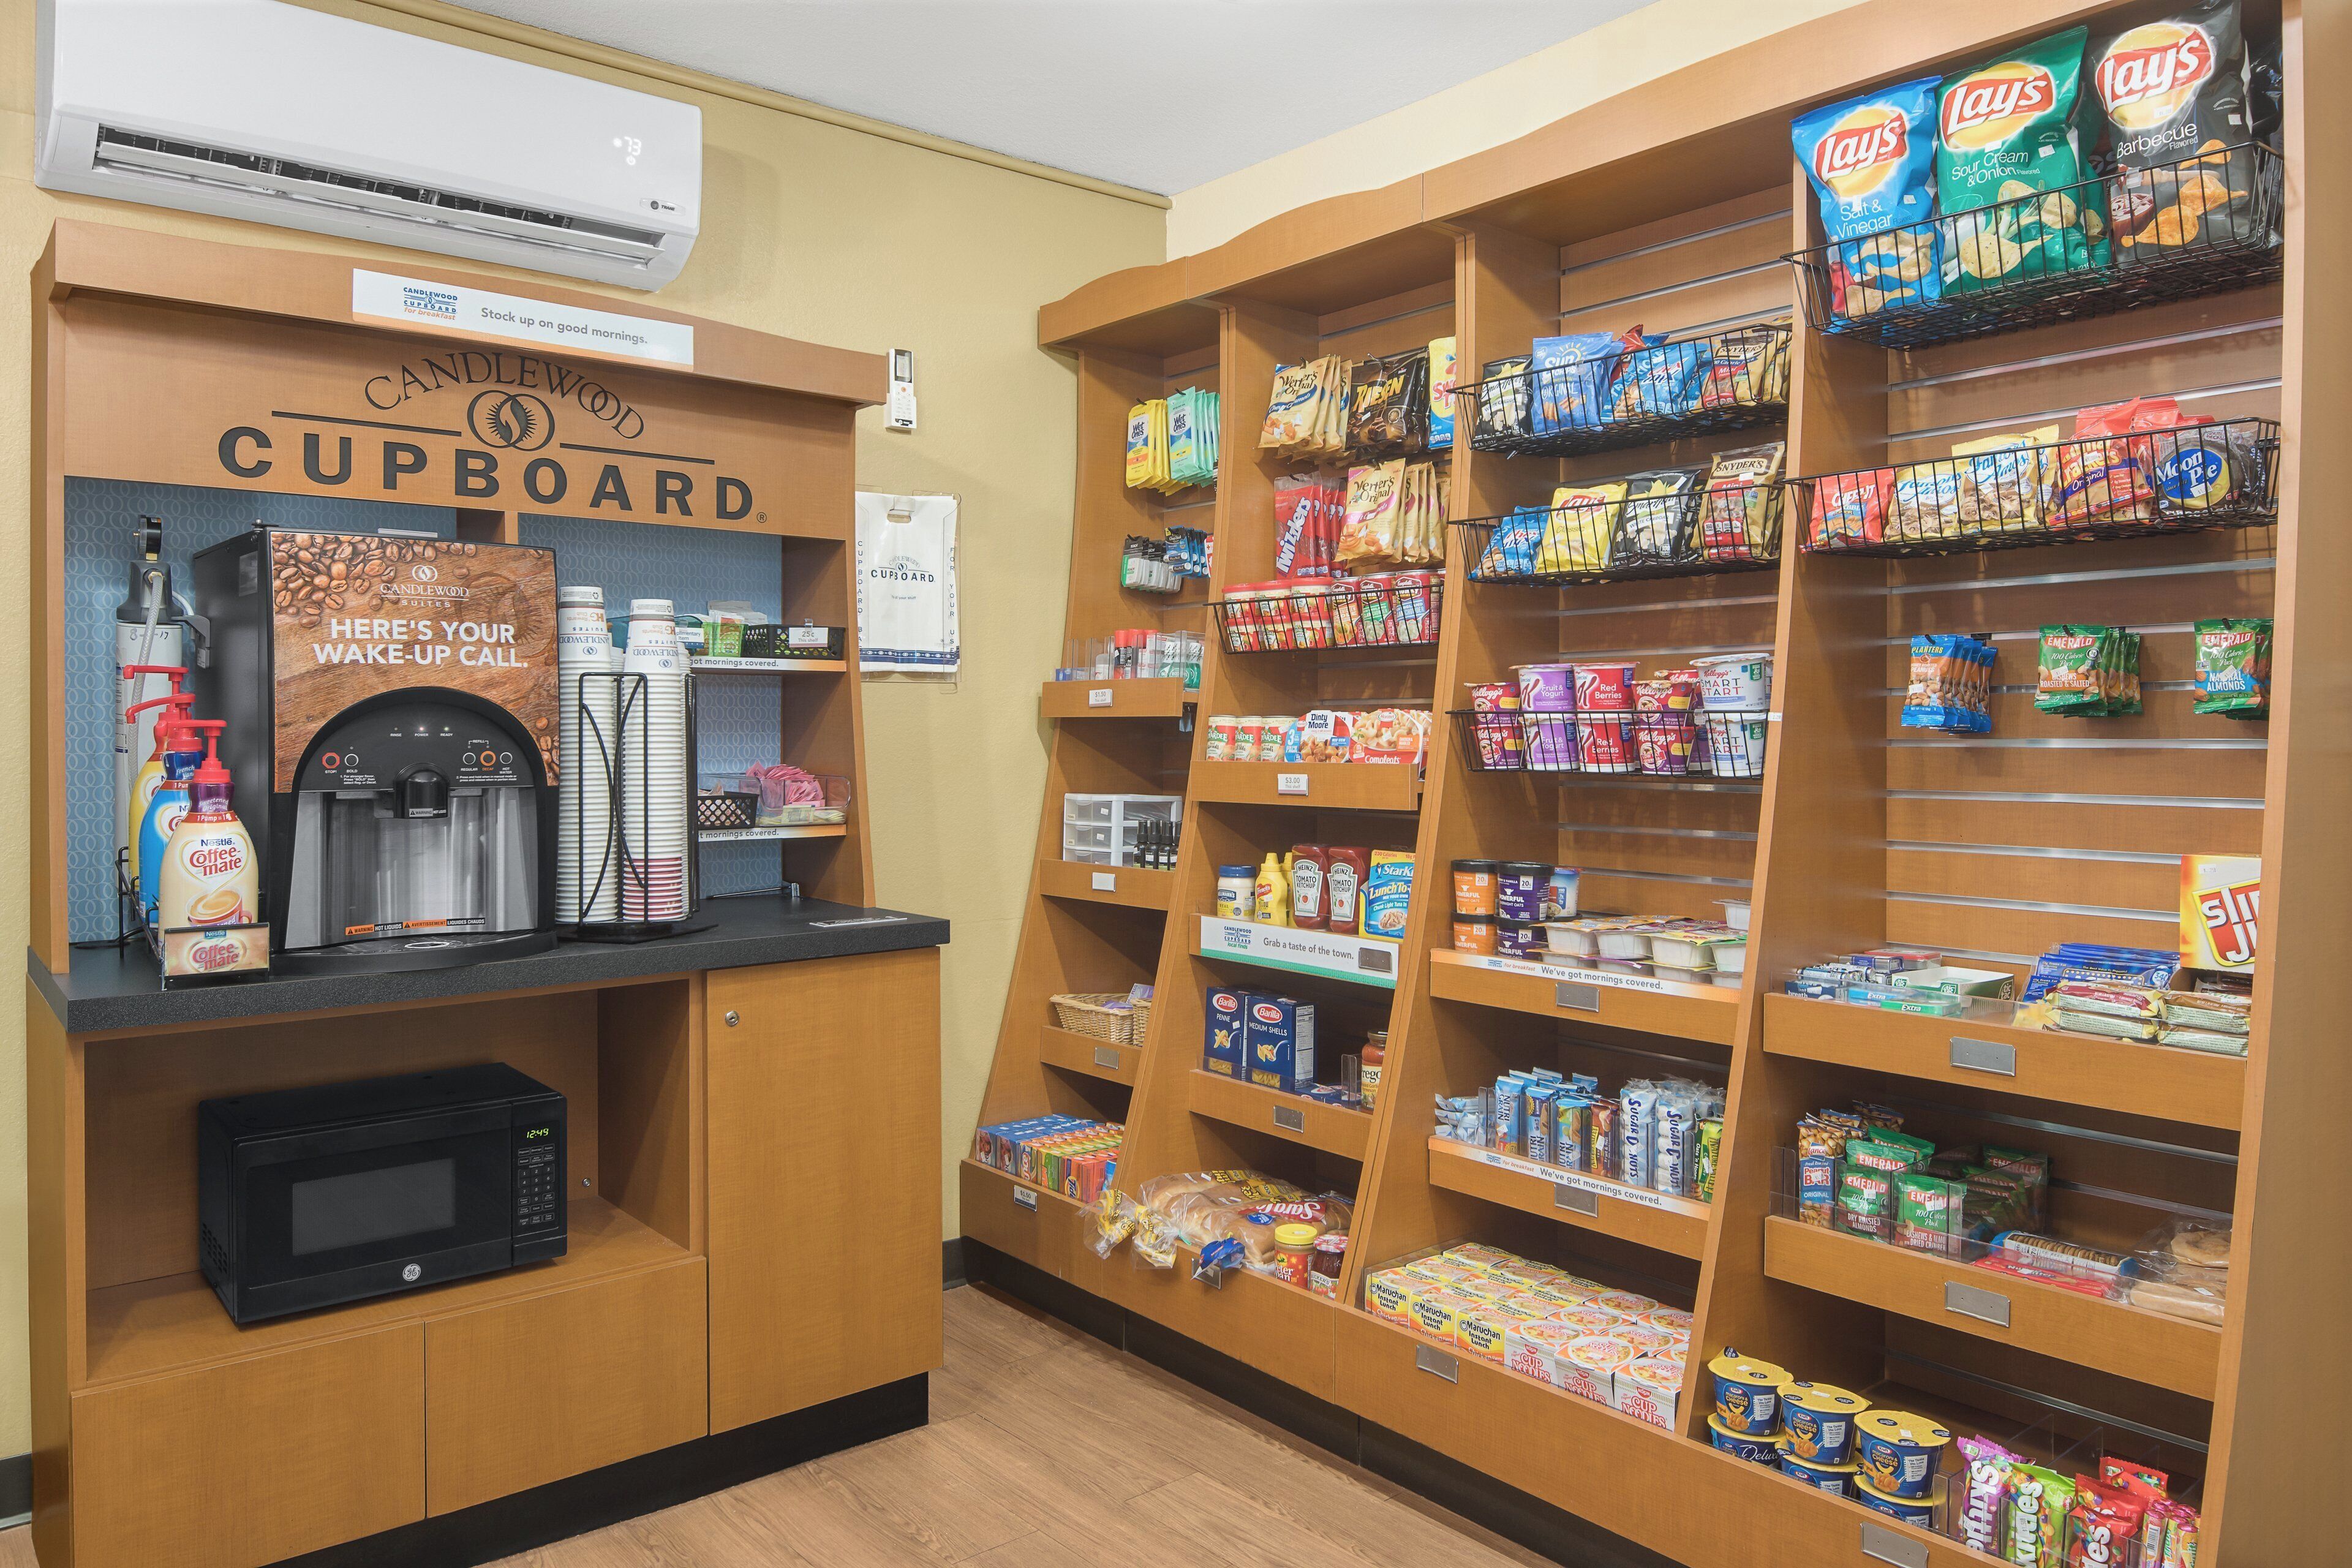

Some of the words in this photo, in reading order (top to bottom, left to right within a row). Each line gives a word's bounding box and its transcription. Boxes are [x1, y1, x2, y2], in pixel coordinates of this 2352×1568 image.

[2104, 38, 2201, 113] Lay's
[1947, 74, 2049, 133] Lay's
[624, 135, 642, 156] 73
[2117, 123, 2198, 159] Barbecue
[2169, 136, 2198, 150] Flavored
[1822, 119, 1901, 181] Lay's
[1952, 159, 1980, 180] Sour
[1983, 151, 2028, 167] Cream
[1841, 204, 1869, 222] Salt
[1873, 199, 1882, 211] &
[1836, 214, 1893, 238] Vinegar
[1893, 214, 1915, 225] Flavored
[403, 287, 458, 301] CANDLEWOOD
[403, 300, 457, 313] CUPBOARD
[404, 306, 416, 315] for
[418, 309, 456, 320] breakfast
[481, 307, 516, 323] Stock
[519, 315, 535, 328] up
[538, 318, 554, 328] on
[557, 318, 588, 334] good
[591, 328, 648, 345] mornings.
[364, 351, 645, 440] CANDLEWOOD
[1352, 375, 1405, 413] RIESEN
[218, 425, 753, 521] CUPBOARD
[1717, 461, 1764, 472] SNYDER'S
[2155, 451, 2201, 484] Moon
[380, 583, 469, 597] CANDLEWOOD
[331, 618, 432, 641] HERE'S
[440, 621, 515, 644] YOUR
[2048, 636, 2094, 649] EMERALD
[2204, 633, 2251, 647] EMERALD
[312, 644, 451, 665] WAKE-UP
[459, 646, 529, 668] CALL.
[1700, 679, 1740, 687] SMART
[2207, 680, 2245, 692] ALMONDS
[1472, 688, 1503, 699] Kellogg's
[1703, 687, 1742, 695] START
[1311, 714, 1328, 723] Dinty
[1365, 755, 1401, 764] Compleats
[198, 798, 229, 807] Sweetened
[706, 829, 743, 839] mornings
[745, 827, 779, 837] covered.
[203, 858, 241, 876] mate
[1296, 875, 1316, 884] TOMATO
[1264, 937, 1280, 949] Grab
[1289, 941, 1306, 951] taste
[1308, 944, 1316, 953] of
[1318, 945, 1330, 954] the
[1332, 948, 1354, 960] town.
[1541, 966, 1566, 976] We've
[1568, 970, 1582, 980] got
[1584, 973, 1623, 985] mornings
[1626, 978, 1663, 990] covered.
[1218, 998, 1235, 1008] Barilla
[1216, 1013, 1231, 1022] PENNE
[1259, 1008, 1280, 1020] Barilla
[1249, 1022, 1267, 1032] MEDIUM
[1268, 1026, 1287, 1036] SHELLS
[1629, 1098, 1642, 1134] SUGAR
[527, 1128, 549, 1139] 12:49
[1510, 1162, 1534, 1172] breakfast
[1859, 1156, 1906, 1170] EMERALD
[1804, 1167, 1830, 1176] Peanut
[1540, 1167, 1564, 1180] We've
[1567, 1176, 1581, 1185] got
[1583, 1180, 1622, 1196] mornings
[1624, 1192, 1662, 1207] covered.
[1847, 1177, 1887, 1194] EMERALD
[1906, 1231, 1927, 1241] CASHEWS
[1910, 1238, 1924, 1248] DRIED
[1377, 1284, 1406, 1302] Maruchan
[1378, 1294, 1398, 1306] Instant
[1380, 1300, 1396, 1311] Lunch
[1520, 1352, 1543, 1368] CUP
[1511, 1359, 1551, 1383] NOODLES
[1725, 1392, 1744, 1400] macaroni
